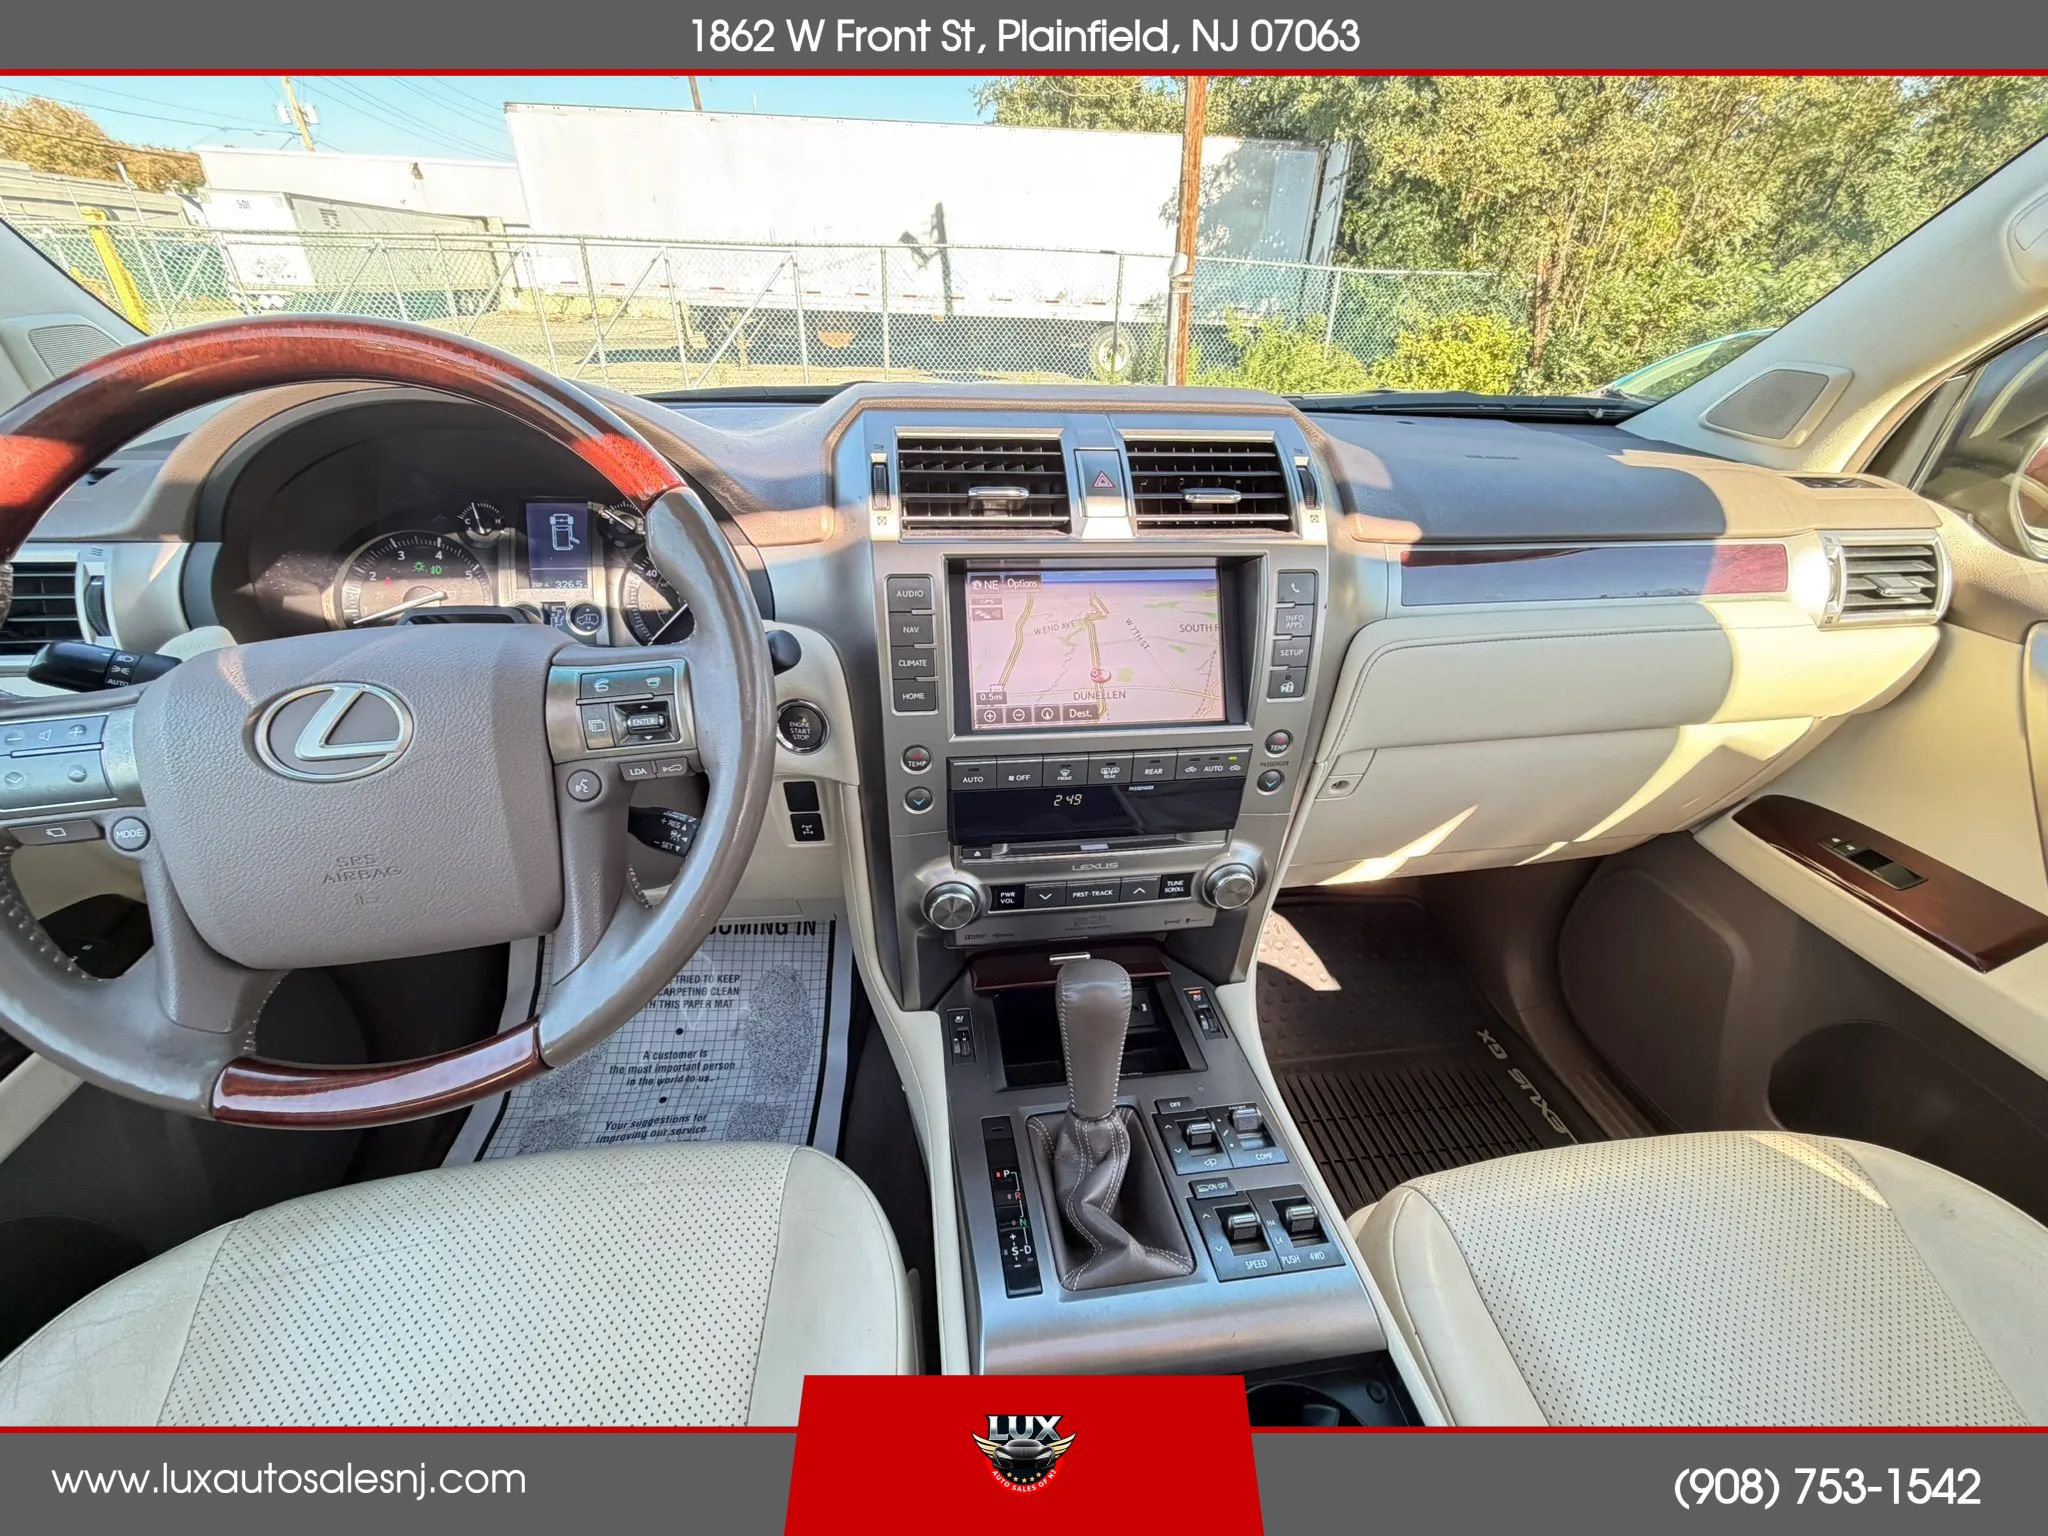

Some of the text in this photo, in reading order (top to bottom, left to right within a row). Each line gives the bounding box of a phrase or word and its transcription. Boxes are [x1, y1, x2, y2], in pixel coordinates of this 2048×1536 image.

[397, 550, 405, 561] 3
[435, 550, 443, 561] 4
[369, 571, 377, 582] 2
[465, 569, 473, 580] 5
[646, 569, 658, 578] 40
[984, 580, 999, 590] NE
[1007, 578, 1038, 590] Options
[896, 590, 924, 598] AUDIO
[1285, 614, 1304, 622] INFO
[903, 626, 920, 634] NAV
[1033, 620, 1076, 635] W END AVE
[1179, 624, 1212, 632] SOUTH
[1280, 649, 1304, 657] SETUP
[898, 659, 928, 667] CLIMATE
[107, 679, 129, 687] AUTO
[902, 692, 926, 700] HOME
[1073, 690, 1126, 700] DUNELLEN
[1069, 707, 1093, 719] Dest.
[632, 717, 656, 727] ENTER
[907, 760, 927, 768] TEMP
[629, 767, 648, 776] LDA
[1016, 774, 1031, 782] OFF
[116, 829, 145, 839] MODE
[336, 854, 377, 868] SRS
[1071, 862, 1120, 872] LEXUS
[322, 866, 403, 885] AIRBAG
[1166, 880, 1184, 888] TUNE
[1000, 891, 1016, 899] PWR
[1164, 886, 1185, 894] SCROLL
[710, 920, 817, 936] OMING IN
[675, 974, 741, 984] TRIED TO KEEP
[710, 986, 740, 996] CLEAN
[660, 999, 680, 1009] THIS
[683, 999, 712, 1009] PAPER
[714, 999, 735, 1009] MAT
[1476, 1029, 1508, 1059] GX
[642, 1050, 650, 1060] A
[652, 1051, 697, 1060] customer
[609, 1061, 736, 1075] the most important person
[626, 1077, 636, 1086] in
[638, 1076, 654, 1086] the
[657, 1074, 684, 1086] world
[685, 1075, 696, 1084] to
[605, 1113, 708, 1131] Your suggestions for
[596, 1125, 708, 1144] improving our service
[1255, 1153, 1274, 1161] COMF
[1003, 1169, 1011, 1179] P
[1014, 1191, 1022, 1201] R
[1019, 1218, 1027, 1228] N
[1281, 1251, 1326, 1266] PUSH 4WD
[1244, 1259, 1268, 1270] SPEED
